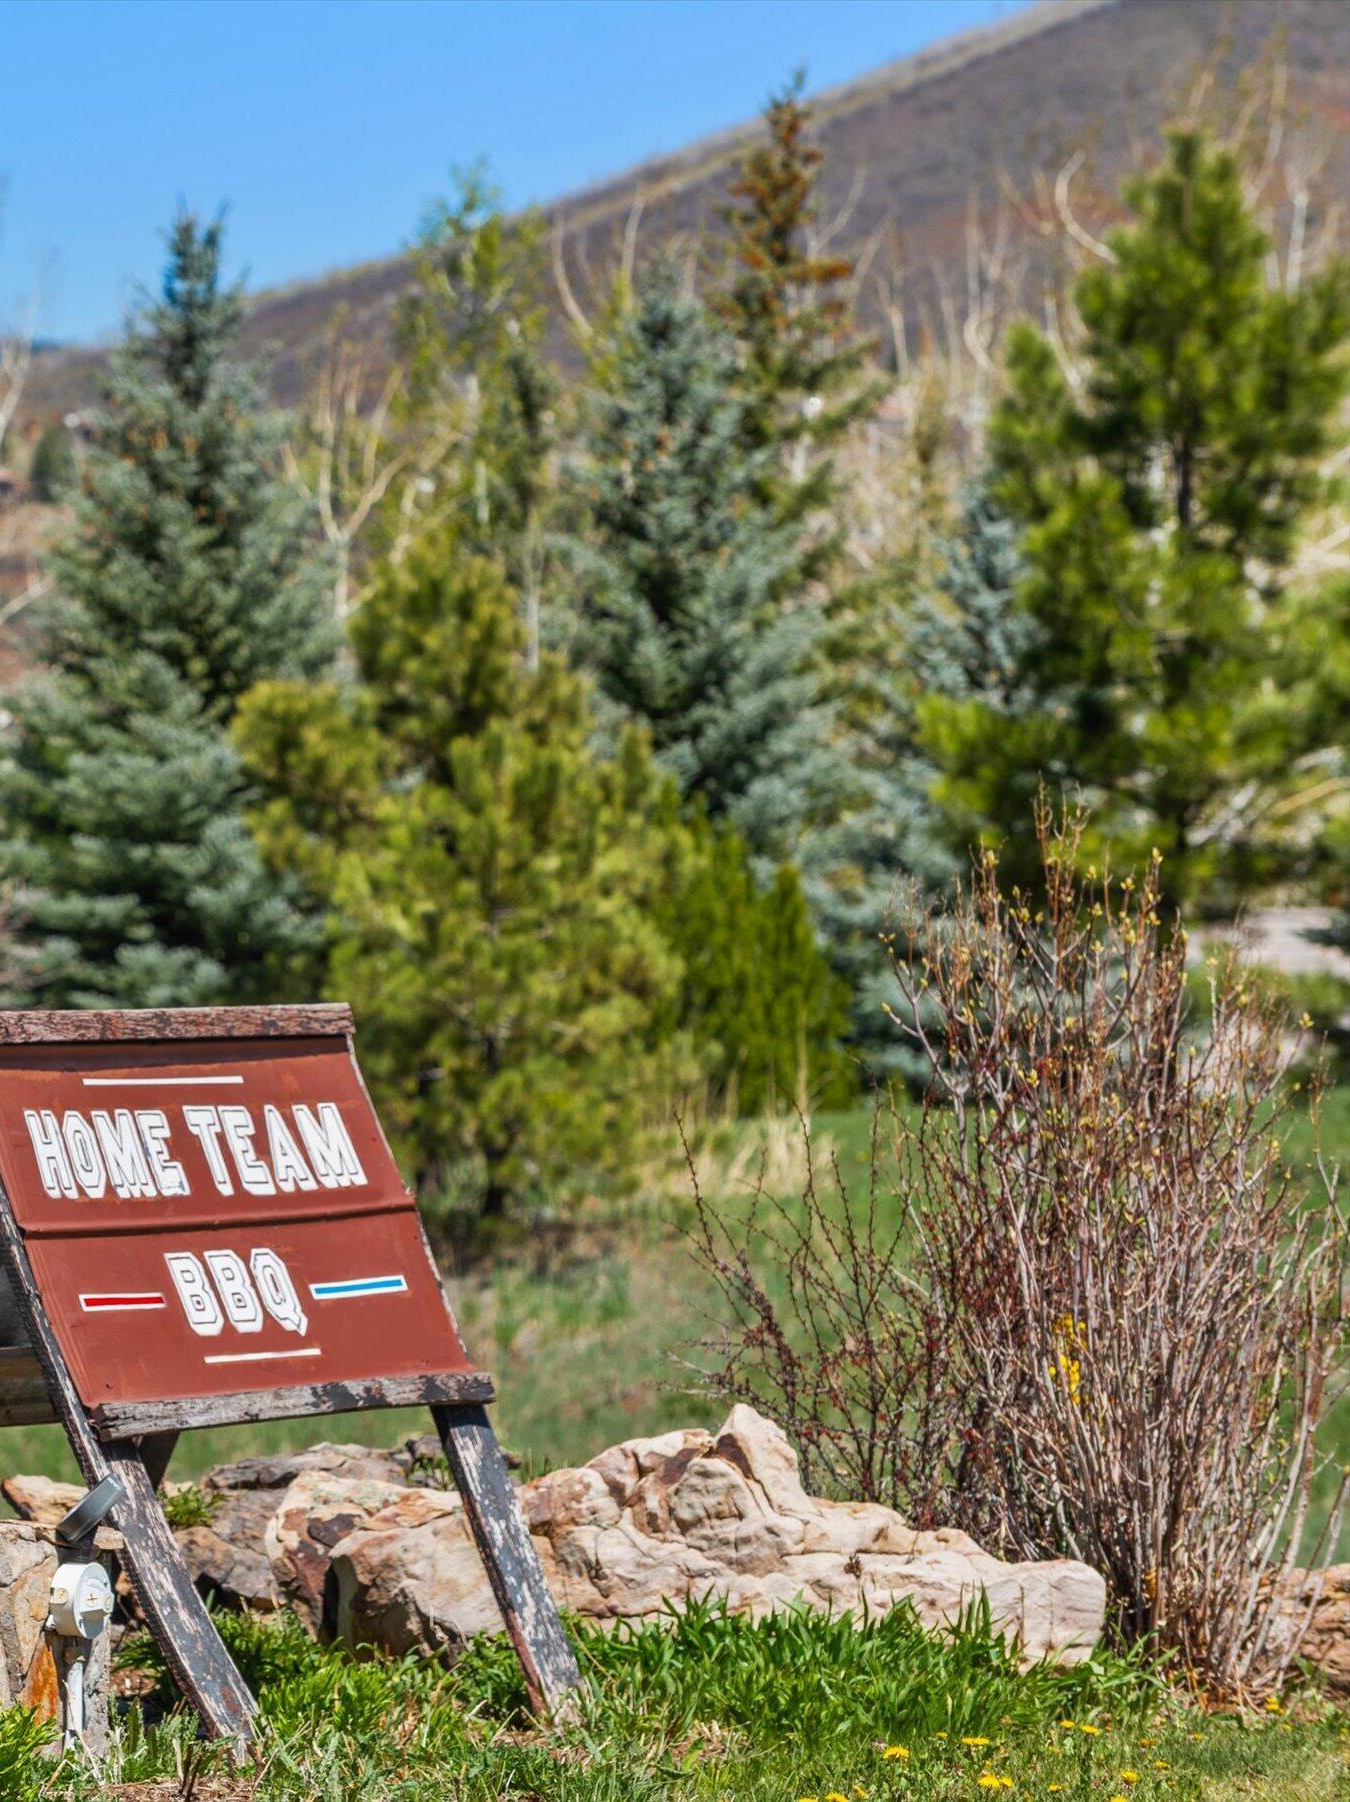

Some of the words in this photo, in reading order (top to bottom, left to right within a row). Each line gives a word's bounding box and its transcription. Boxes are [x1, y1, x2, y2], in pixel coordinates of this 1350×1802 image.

[24, 1108, 190, 1198] HOME
[182, 1103, 368, 1196] TEAM
[164, 1248, 308, 1336] BBQ
